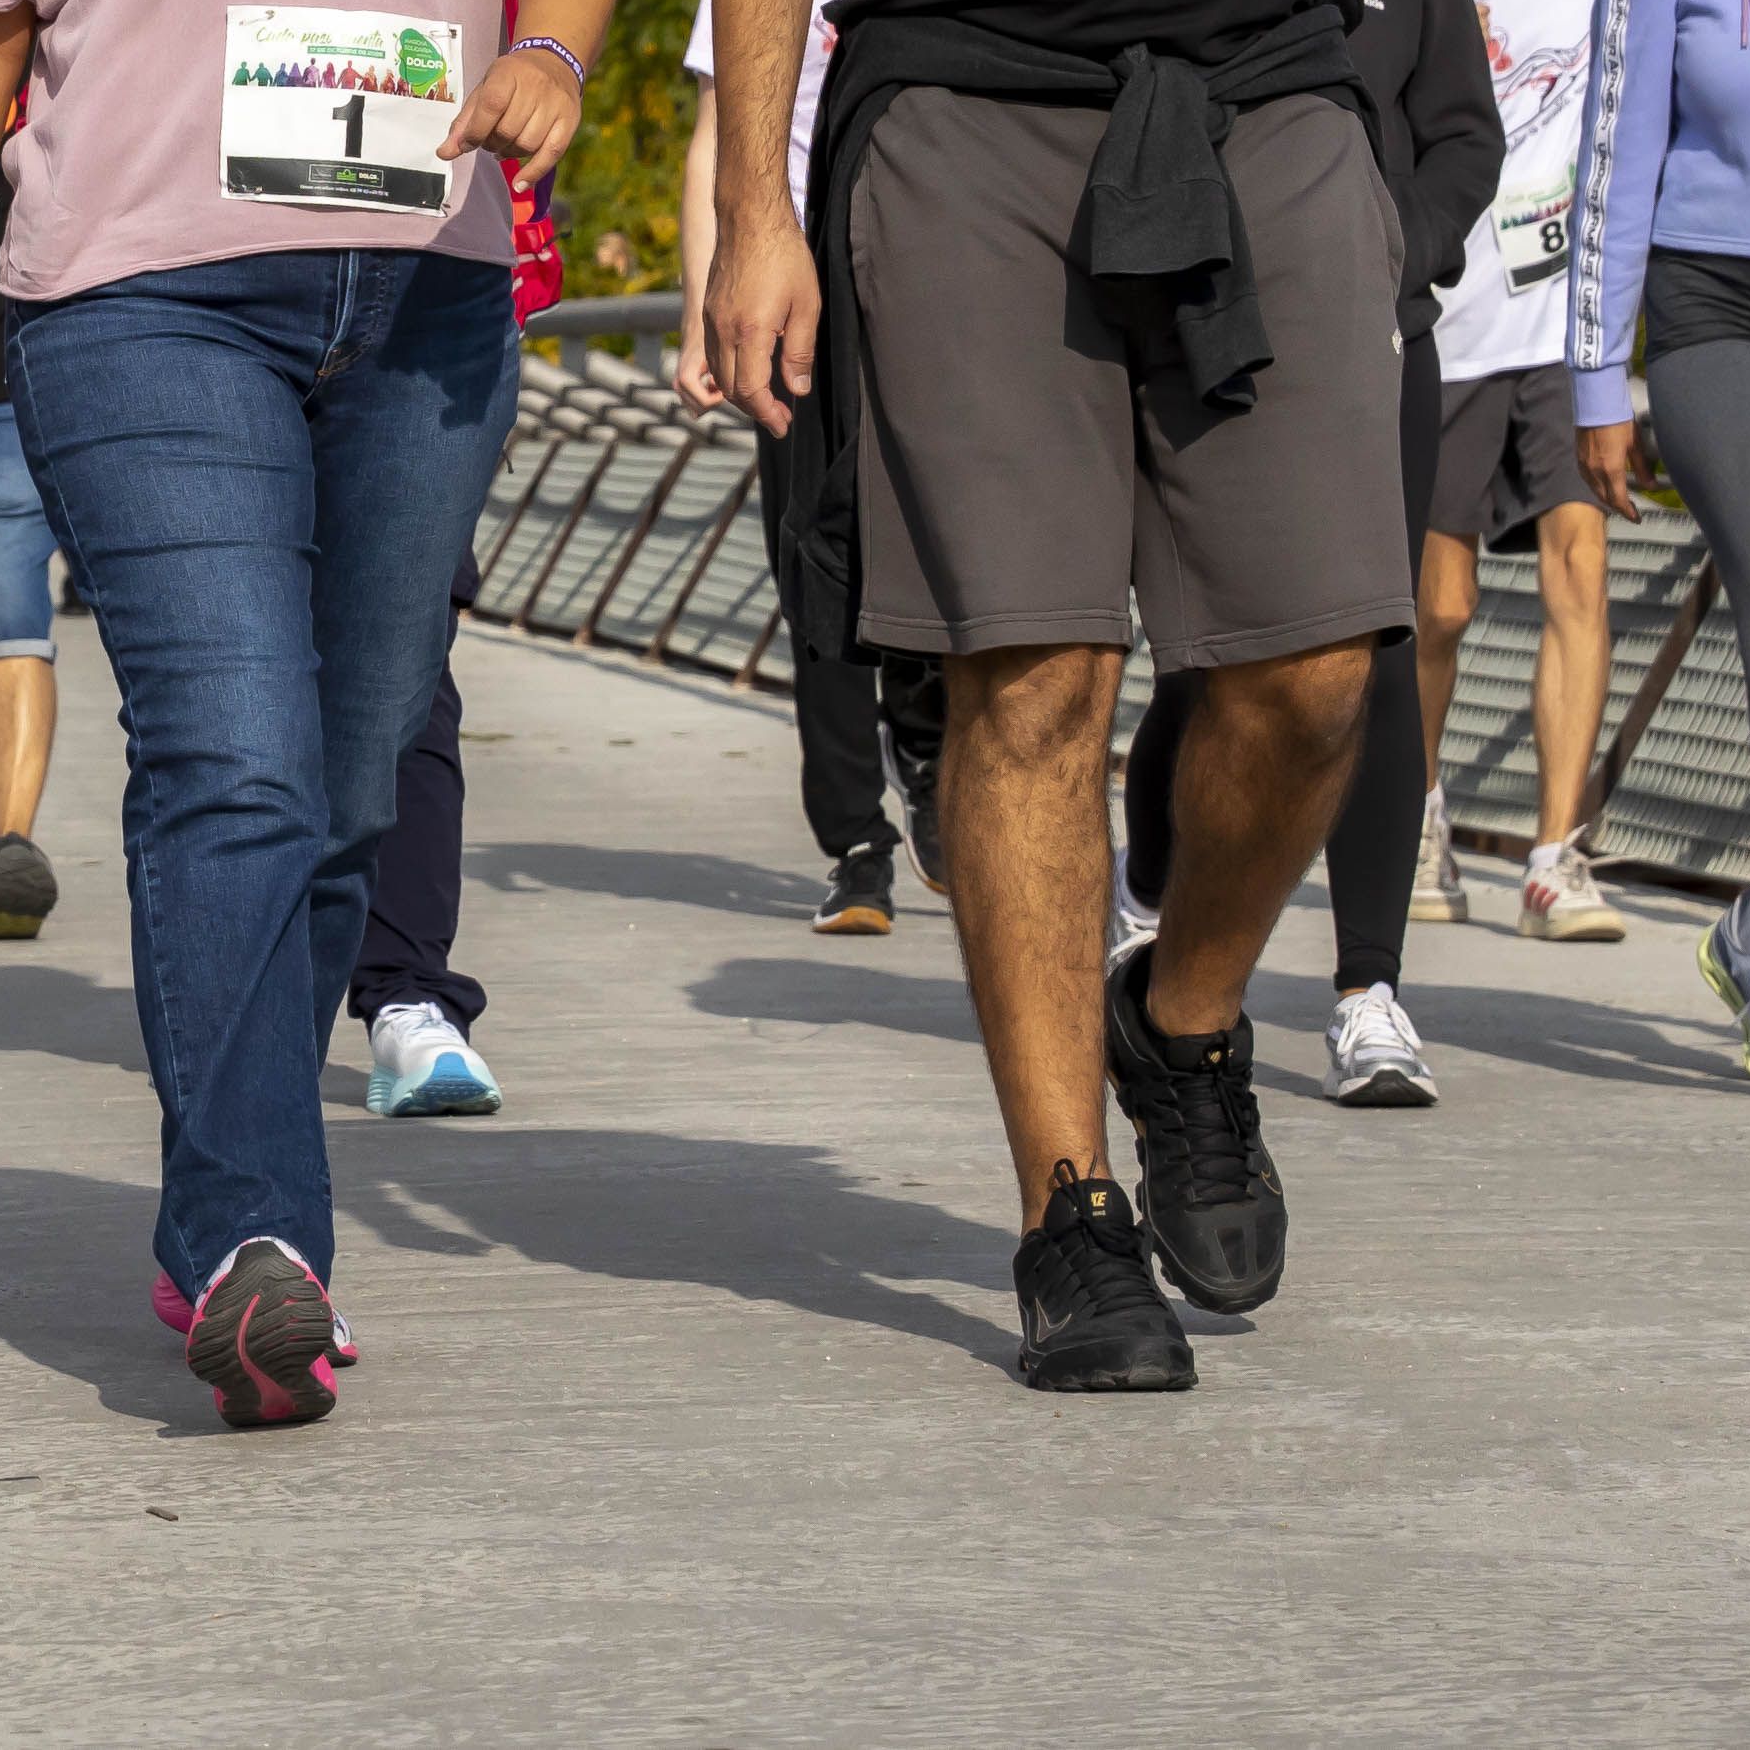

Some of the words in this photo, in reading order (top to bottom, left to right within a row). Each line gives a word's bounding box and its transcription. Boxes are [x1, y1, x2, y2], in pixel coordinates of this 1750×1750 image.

[406, 56, 444, 69] DOLOR
[332, 94, 365, 158] 1
[1090, 1191, 1107, 1207] KE
